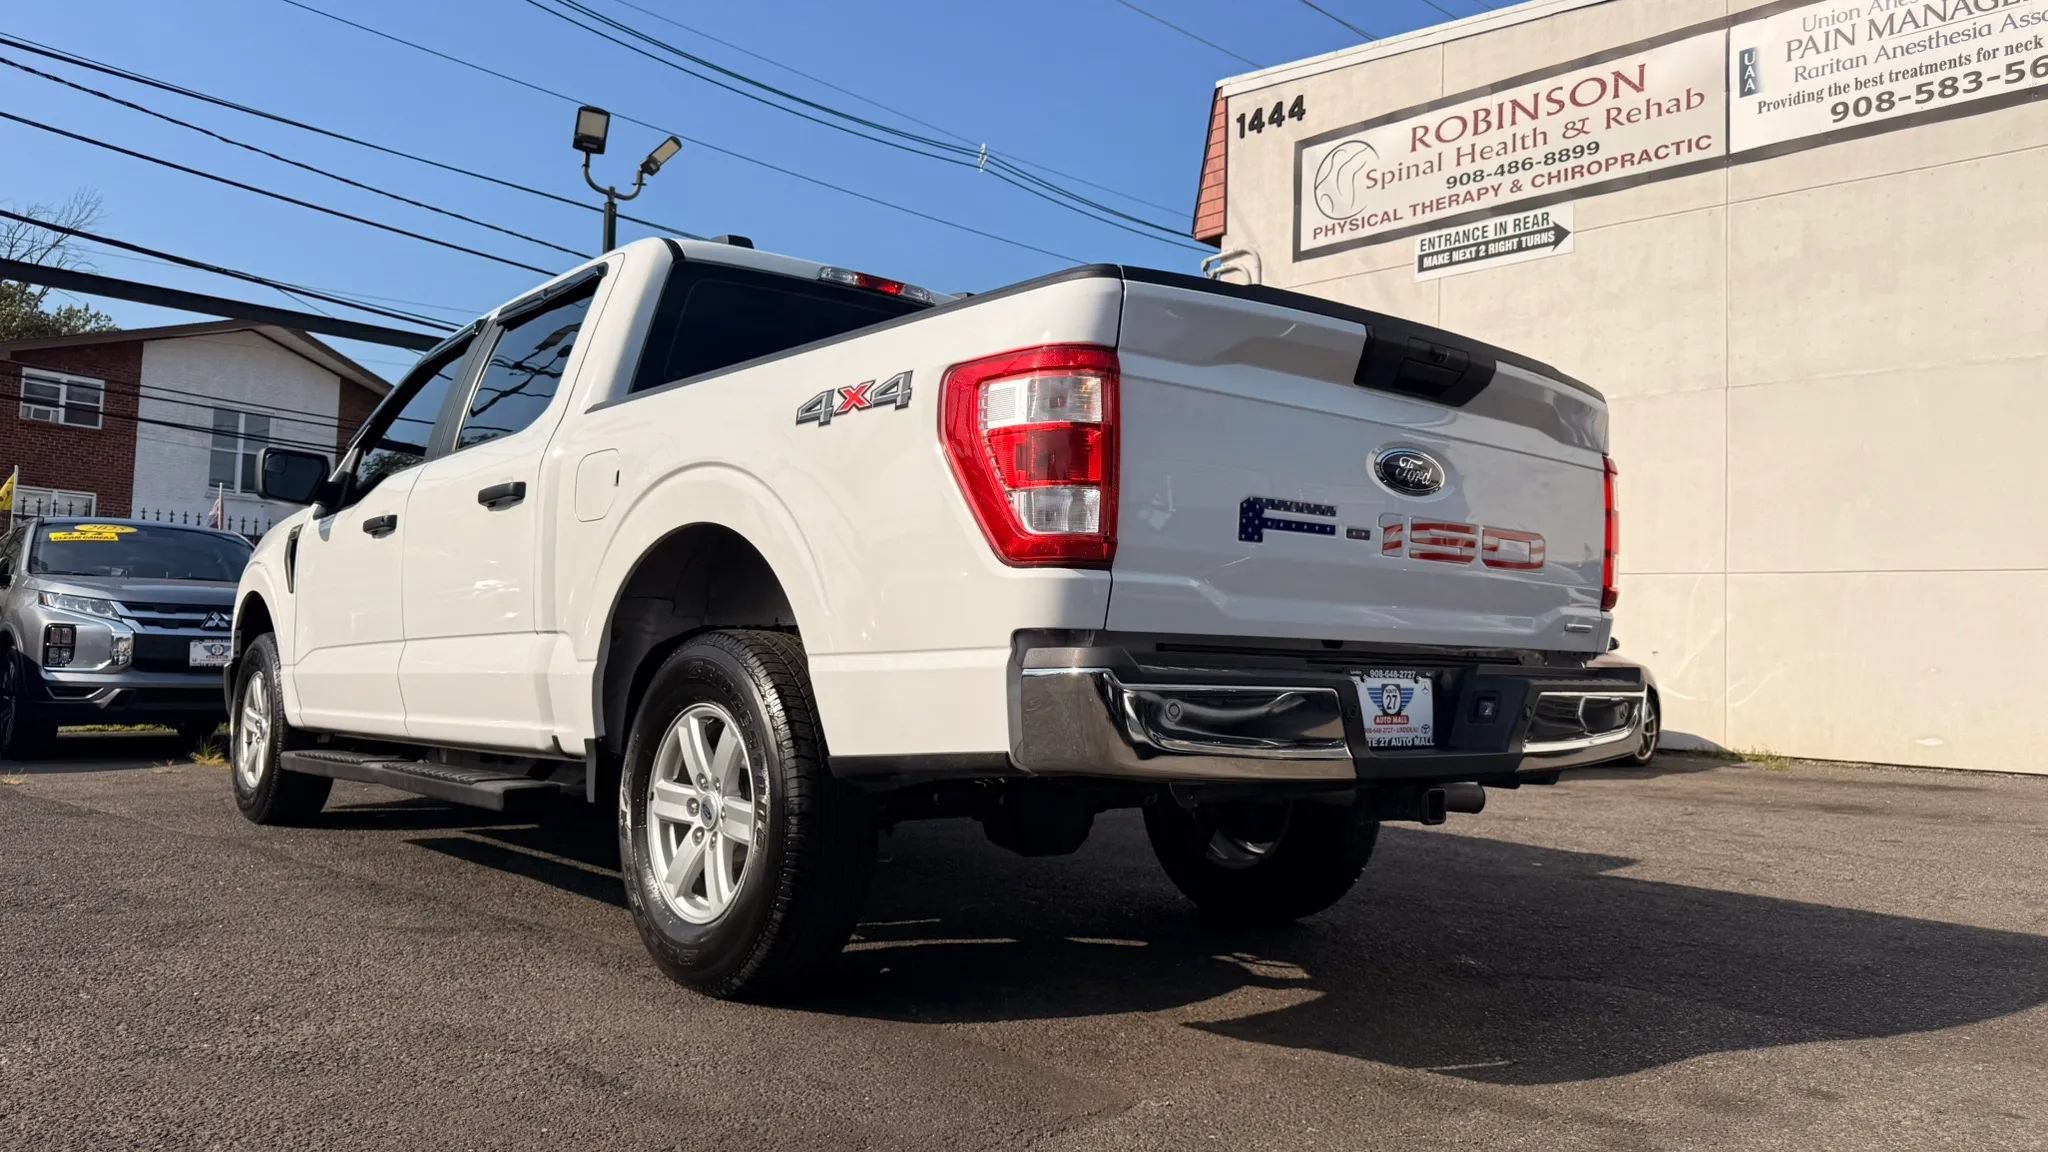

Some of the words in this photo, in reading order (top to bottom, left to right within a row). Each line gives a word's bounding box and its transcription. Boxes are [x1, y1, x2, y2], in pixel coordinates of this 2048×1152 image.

[1802, 7, 1861, 33] Union
[1785, 22, 1857, 63] PAIN
[1794, 54, 1868, 83] Raritan
[1874, 21, 1993, 64] Anesthesia
[1757, 87, 1825, 115] Providing
[1828, 82, 1850, 98] the
[1855, 72, 1884, 92] best
[1889, 53, 1972, 84] treatments
[1976, 46, 2000, 64] for
[2004, 34, 2044, 57] neck
[1235, 94, 1306, 139] 1444
[1410, 63, 1647, 153] ROBINSON
[1365, 151, 1443, 190] Spinal
[1455, 126, 1549, 168] Health
[1562, 117, 1592, 140] &
[1604, 87, 1706, 130] Rehab
[1445, 140, 1601, 190] 908-486-8899
[1313, 208, 1404, 241] PHYSICAL
[1409, 183, 1503, 217] THERAPY
[1509, 179, 1523, 194] &
[1531, 134, 1713, 189] CHIROPRACTIC
[1420, 224, 1489, 253] ENTRANCE
[1494, 220, 1508, 237] IN
[1513, 211, 1550, 233] REAR
[1423, 252, 1451, 269] MAKE
[1451, 246, 1477, 263] NEXT
[1479, 244, 1487, 258] 2
[1488, 237, 1519, 256] RIGHT
[1520, 230, 1556, 249] TURNS
[1395, 456, 1433, 485] Ford
[1237, 496, 1546, 576] F-150
[1369, 669, 1417, 679] 908-648-2727
[1375, 715, 1392, 724] AUTO
[1392, 715, 1408, 724] MALL
[1385, 694, 1398, 710] 27
[1380, 737, 1389, 747] 27
[1390, 737, 1413, 747] AUTO
[1413, 736, 1435, 746] MALL
